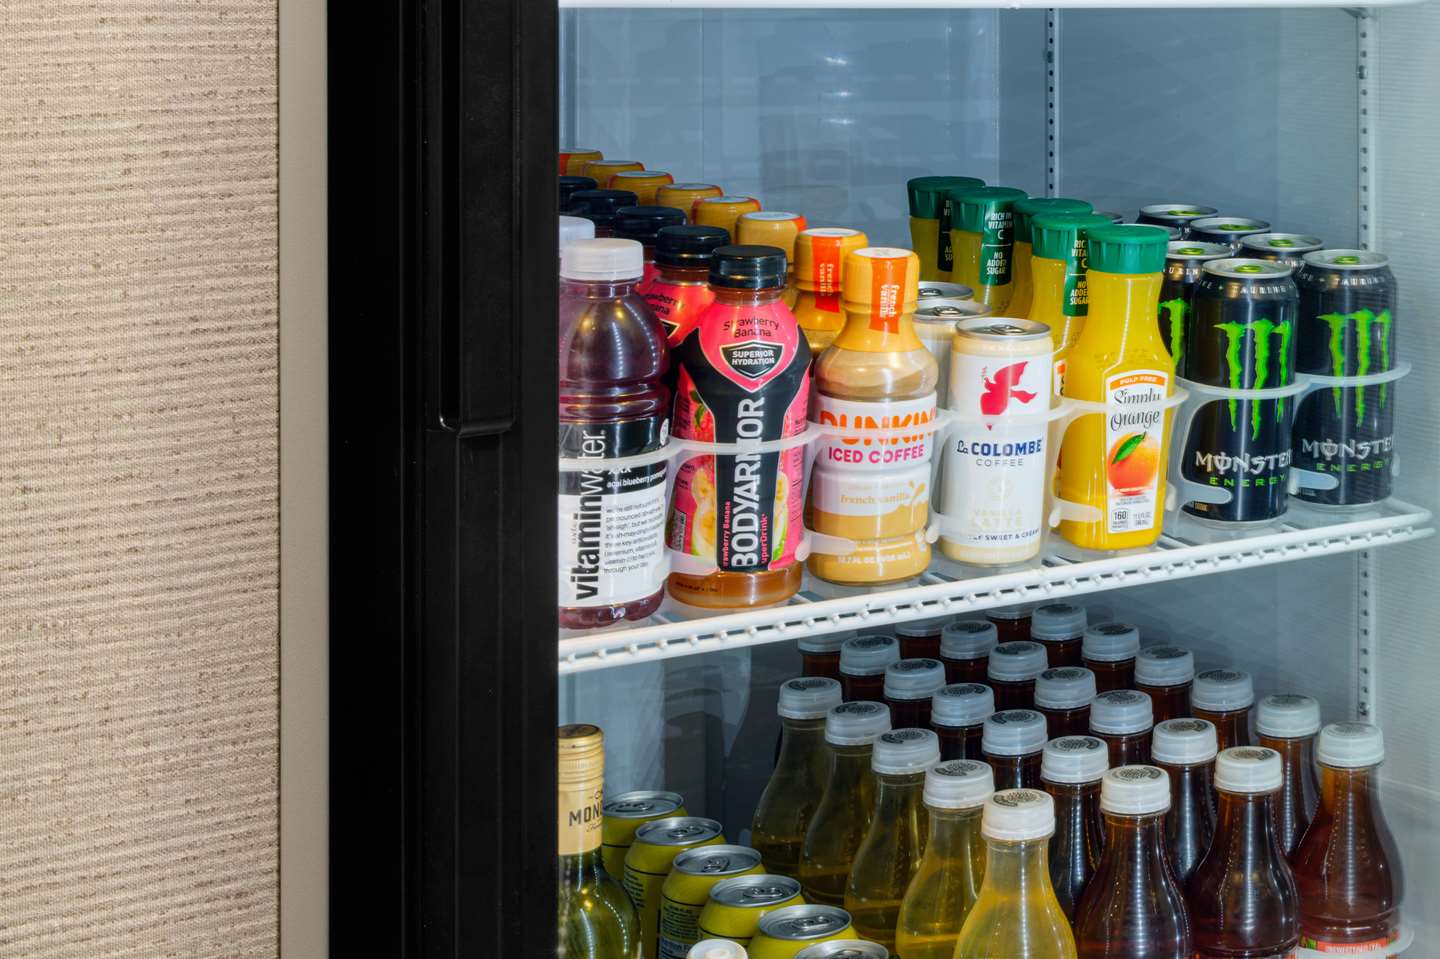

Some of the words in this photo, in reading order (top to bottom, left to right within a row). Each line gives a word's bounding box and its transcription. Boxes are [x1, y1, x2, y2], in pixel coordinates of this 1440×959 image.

[990, 211, 1005, 222] RICH
[988, 220, 1014, 231] VITAMIN
[997, 229, 1005, 241] C
[993, 250, 1004, 260] NO
[986, 259, 1008, 268] ADDED
[986, 266, 1008, 276] SUGAR
[1077, 279, 1088, 290] NO
[879, 283, 889, 319] vanilla
[889, 283, 901, 318] french
[733, 327, 773, 339] Banana
[731, 349, 775, 359] SUPERIOR
[731, 357, 776, 367] HYDRATION
[1119, 375, 1138, 386] PULP
[1139, 374, 1158, 384] FREE
[1110, 409, 1160, 432] Orange
[828, 446, 864, 463] ICED
[868, 443, 925, 464] COFFEE
[956, 439, 969, 455] La
[970, 439, 1043, 457] COLOMBE
[975, 458, 1024, 468] COFFEE
[622, 473, 650, 487] blueberry
[730, 395, 767, 568] BODYARMOR
[1208, 474, 1287, 487] ENERGY
[840, 493, 875, 505] french
[722, 500, 732, 529] Banana
